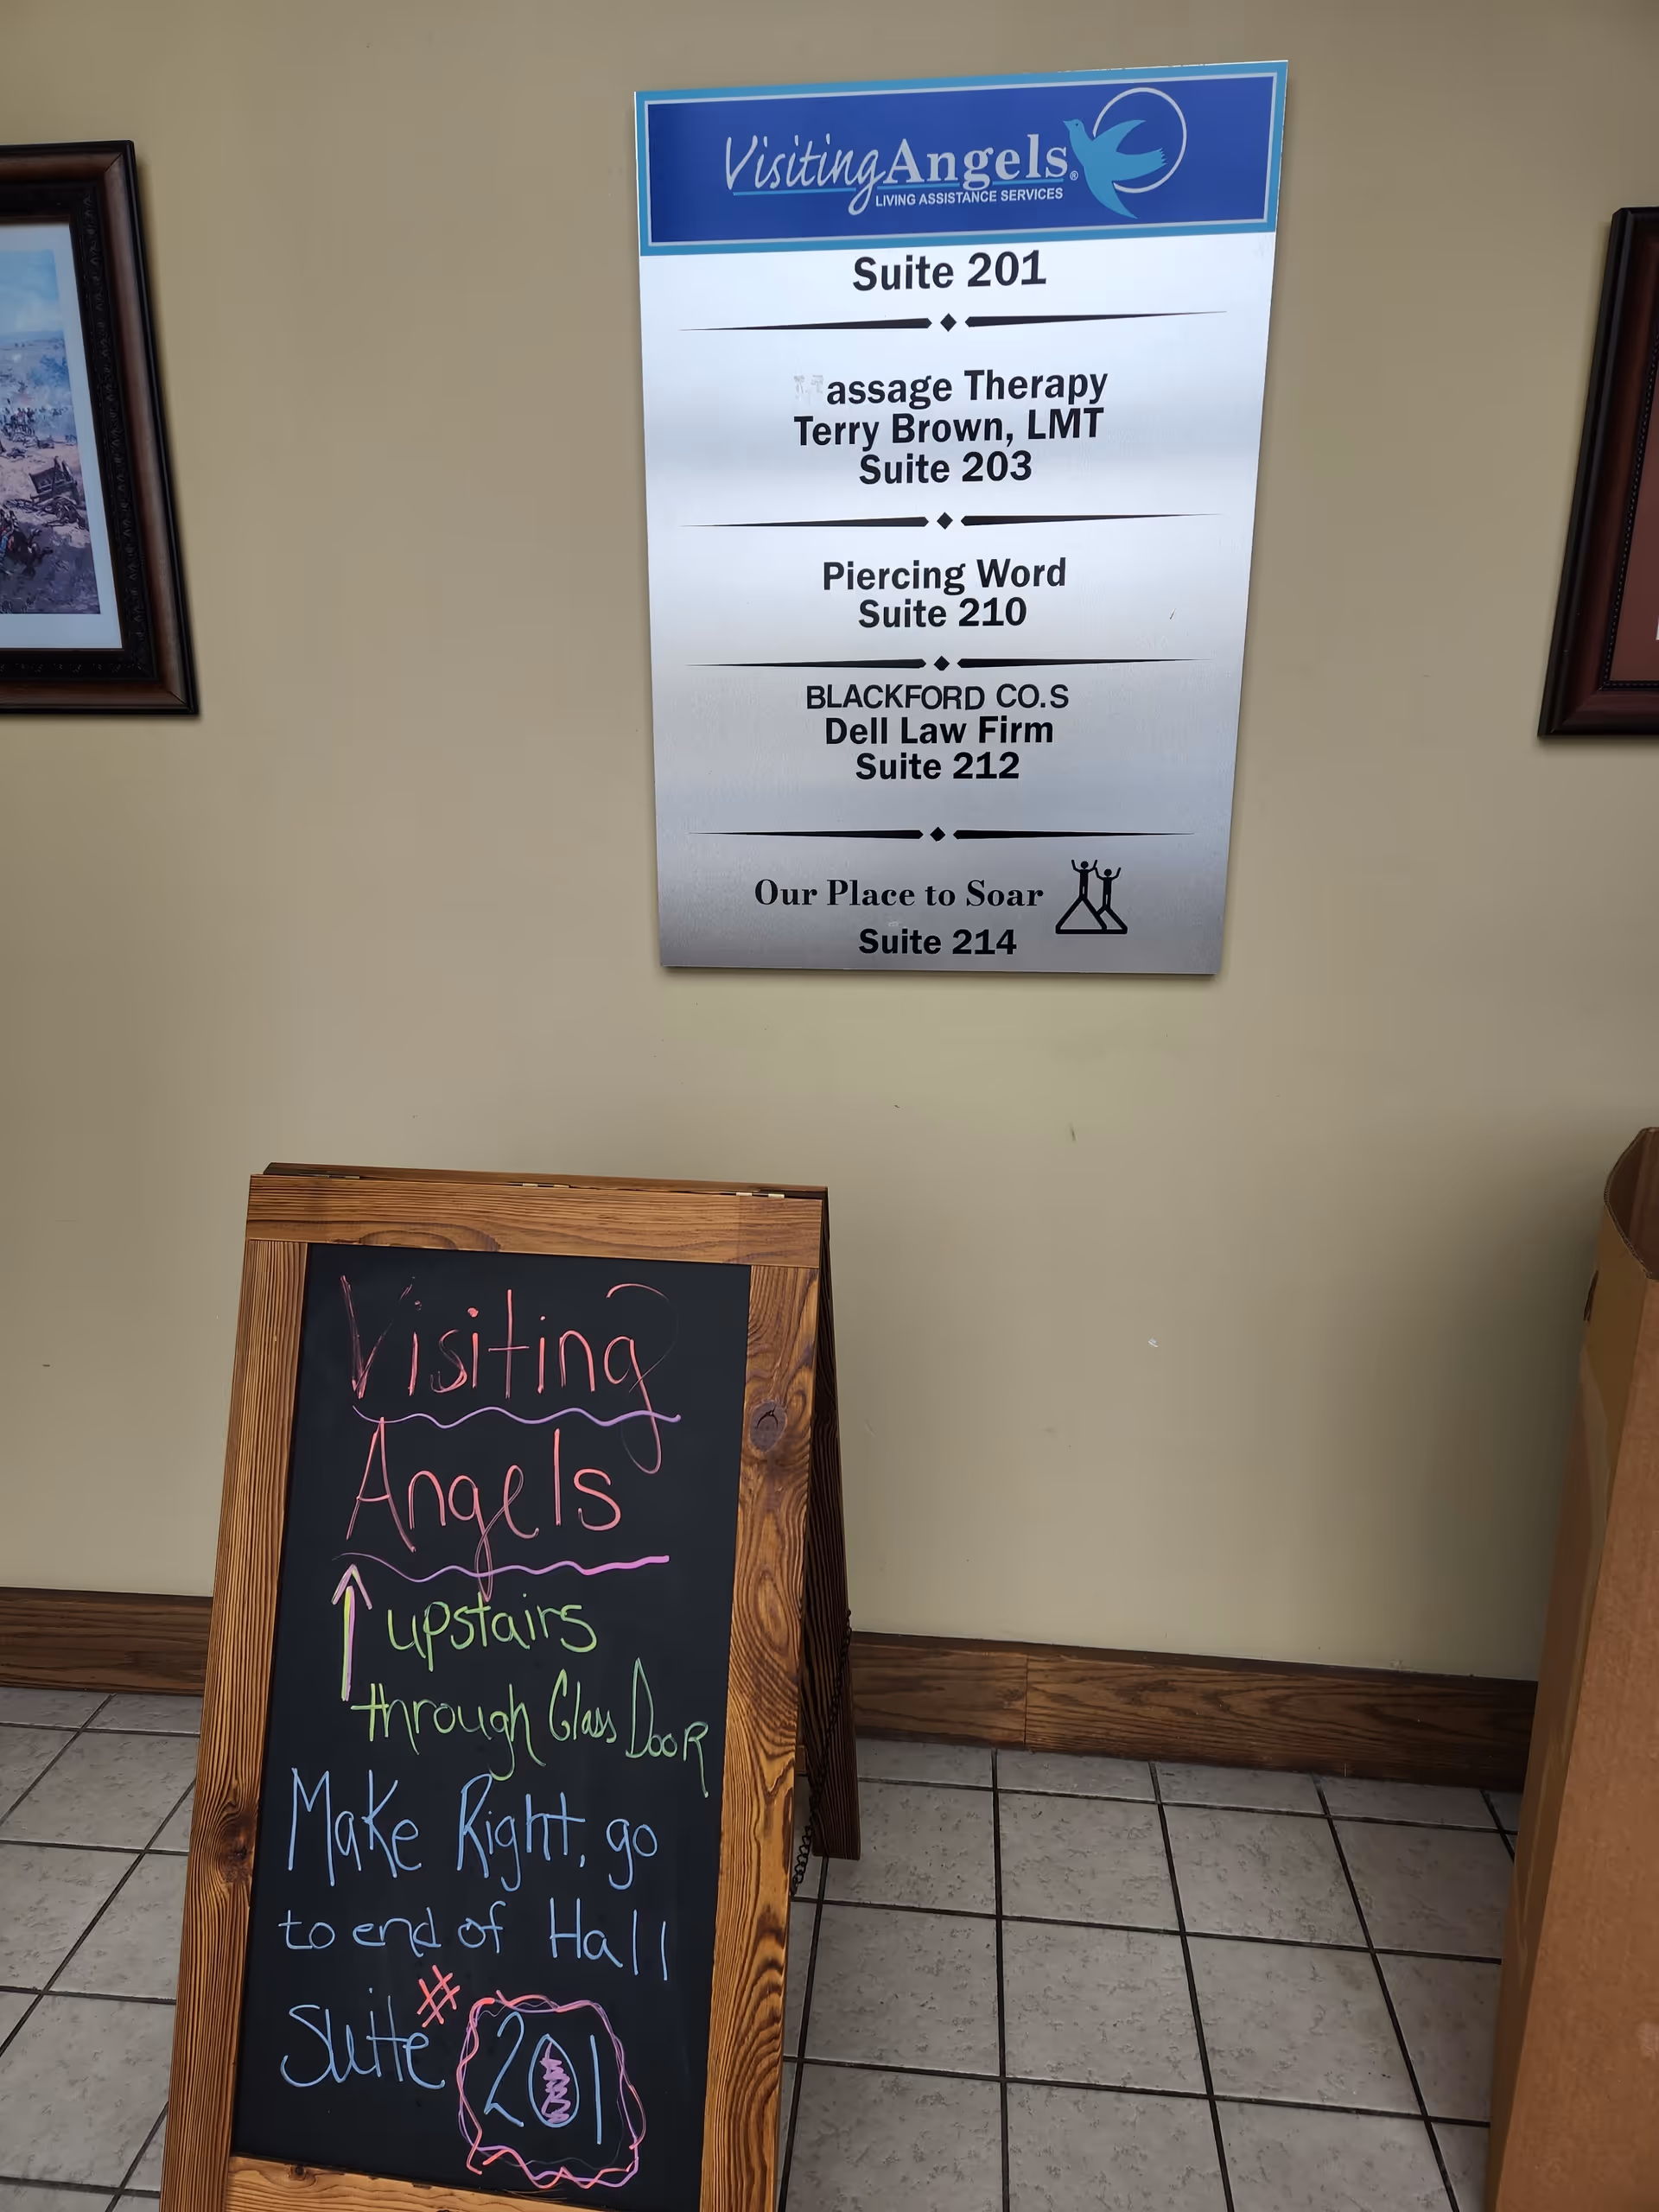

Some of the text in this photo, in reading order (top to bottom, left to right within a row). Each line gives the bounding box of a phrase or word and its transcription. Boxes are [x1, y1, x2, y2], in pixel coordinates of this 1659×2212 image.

[875, 188, 1064, 207] LIVING ASSISTANCE SERVICES
[854, 251, 1046, 290] Suite 201
[793, 370, 1108, 410] assage Therapy
[794, 408, 1104, 452] Terry Brown, LMT
[860, 450, 1032, 485] Suite 203
[823, 557, 1066, 595] Piercing Word
[859, 597, 1027, 628] Suite 210
[806, 683, 1069, 710] BLACKFORD CO.S
[825, 715, 1053, 744] Dell Law Firm
[856, 751, 1020, 779] Suite 212
[755, 879, 1044, 907] Our Place to Soar
[859, 929, 1017, 955] Suite 214
[340, 1275, 679, 1474] Visiting
[346, 1417, 621, 1602] Angels
[387, 1592, 597, 1672] upstairs
[351, 1683, 546, 1781] through
[549, 1669, 617, 1743] Glass
[456, 1773, 586, 1891] Right,
[606, 1818, 658, 1890] go
[277, 1897, 668, 1980] to end of Hall
[483, 2011, 602, 2145] 201
